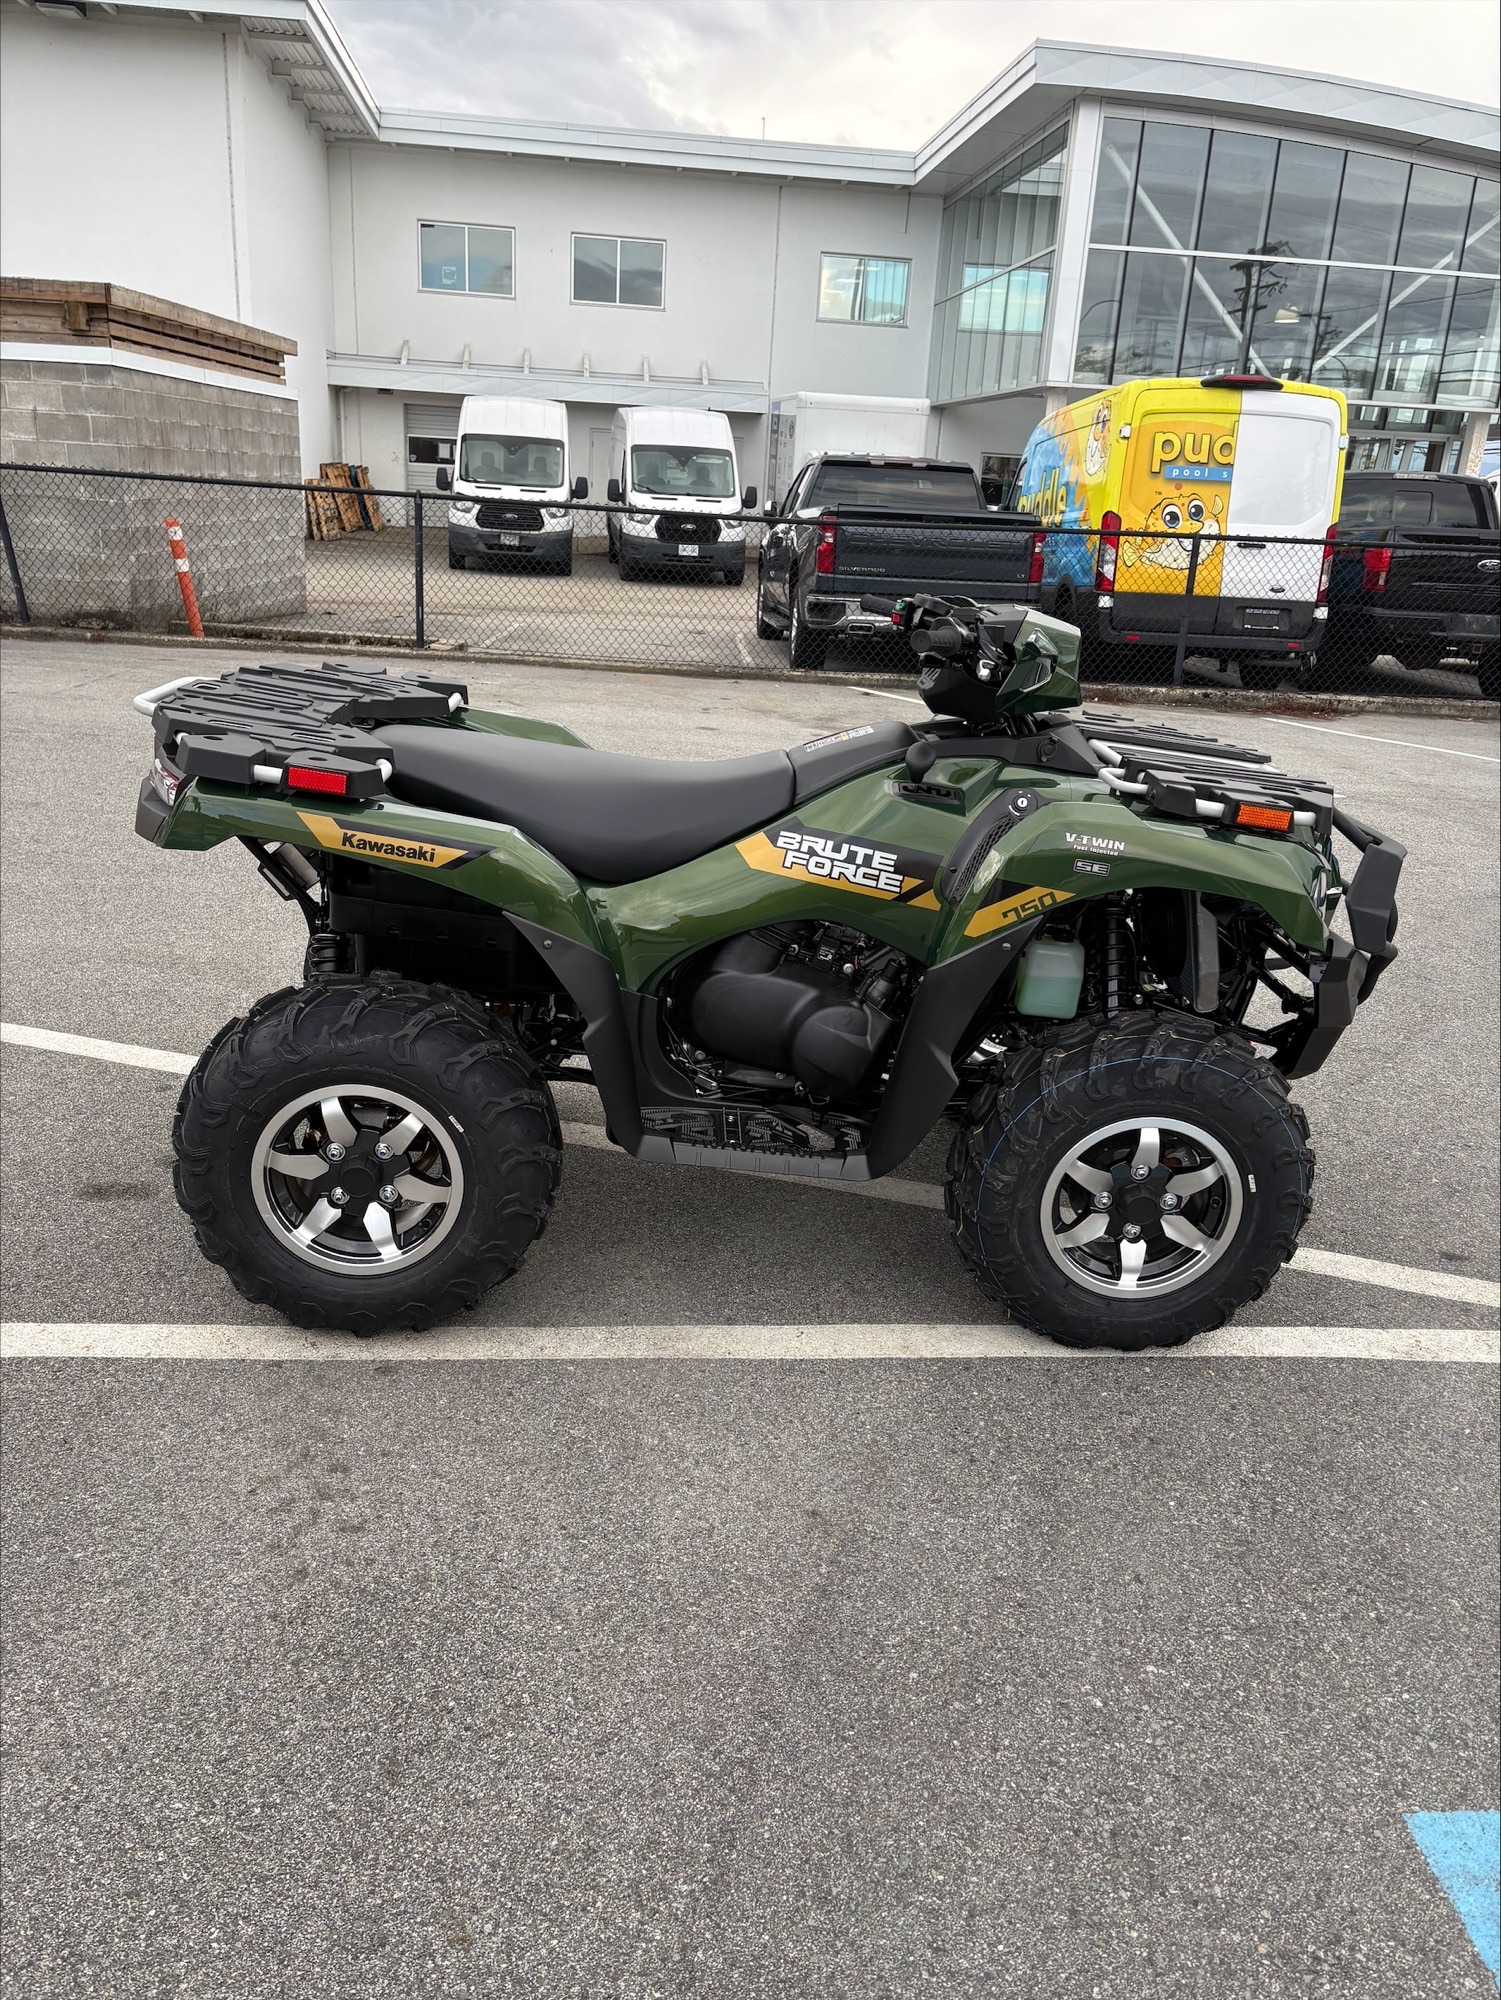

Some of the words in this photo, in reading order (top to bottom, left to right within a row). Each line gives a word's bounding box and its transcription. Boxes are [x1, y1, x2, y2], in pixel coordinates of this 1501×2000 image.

[1151, 421, 1239, 473] pud
[1172, 468, 1208, 477] pool
[838, 565, 886, 573] SILVERADO
[341, 832, 436, 863] Kawasaki
[776, 830, 898, 873] BRUTE
[1065, 832, 1126, 851] V-TWIN
[782, 850, 904, 894] FORCE
[1076, 861, 1109, 874] SE
[1001, 891, 1057, 921] 750
